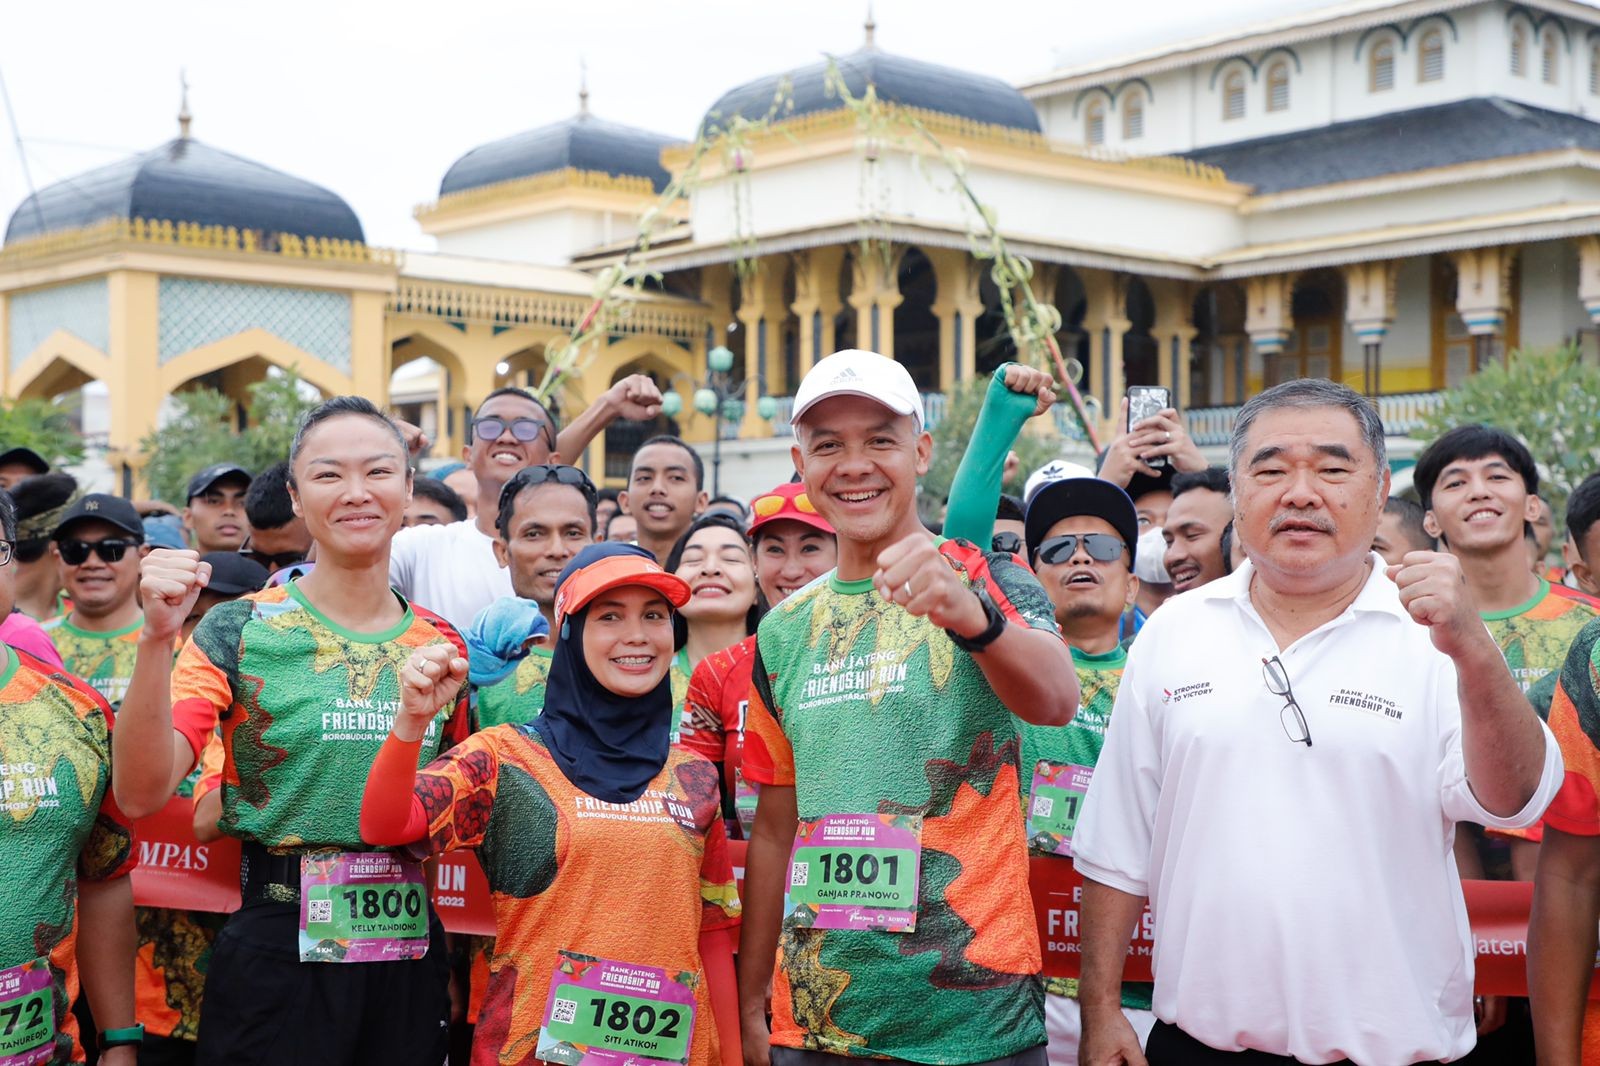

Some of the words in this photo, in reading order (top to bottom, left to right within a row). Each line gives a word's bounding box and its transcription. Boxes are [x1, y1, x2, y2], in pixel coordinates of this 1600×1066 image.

[813, 656, 846, 674] BANK
[846, 650, 897, 669] JATENG
[800, 669, 876, 699] FRIENDSHIP
[879, 663, 908, 684] RUN
[1174, 682, 1211, 696] STRONGER
[335, 698, 374, 709] BANK
[799, 696, 842, 711] BOROBUDUR
[1174, 695, 1181, 703] TO
[1183, 688, 1214, 699] VICTORY
[1340, 689, 1363, 698] BANK
[1364, 693, 1396, 708] JATENG
[1329, 694, 1383, 712] FRIENDSHIP
[1384, 707, 1403, 720] RUN
[322, 733, 373, 741] BOROBUDUR
[22, 777, 58, 797] RUN
[577, 812, 629, 822] BOROBUDUR
[629, 815, 675, 824] MARATHON
[667, 802, 694, 820] RUN
[846, 818, 869, 826] JATENG
[824, 826, 860, 836] FRIENDSHIP
[861, 826, 876, 836] RUN
[350, 864, 390, 874] FRIENDSHIP
[438, 863, 466, 891] UN
[820, 853, 898, 886] 1801
[437, 896, 465, 907] 2022
[817, 889, 848, 900] GANJAR
[850, 891, 900, 900] PRANOWO
[343, 889, 421, 919] 1800
[352, 924, 376, 933] KELLY
[378, 923, 417, 933] TANDIONO
[601, 971, 645, 987] FRIENDSHIP
[645, 979, 660, 990] RUN
[610, 966, 630, 974] BANK
[630, 969, 656, 979] JATENG
[1, 997, 43, 1036] 72
[590, 998, 681, 1039] 1802
[1, 1027, 48, 1050] TANUREDJO
[604, 1034, 622, 1045] SITI
[623, 1037, 658, 1050] ATIKOH
